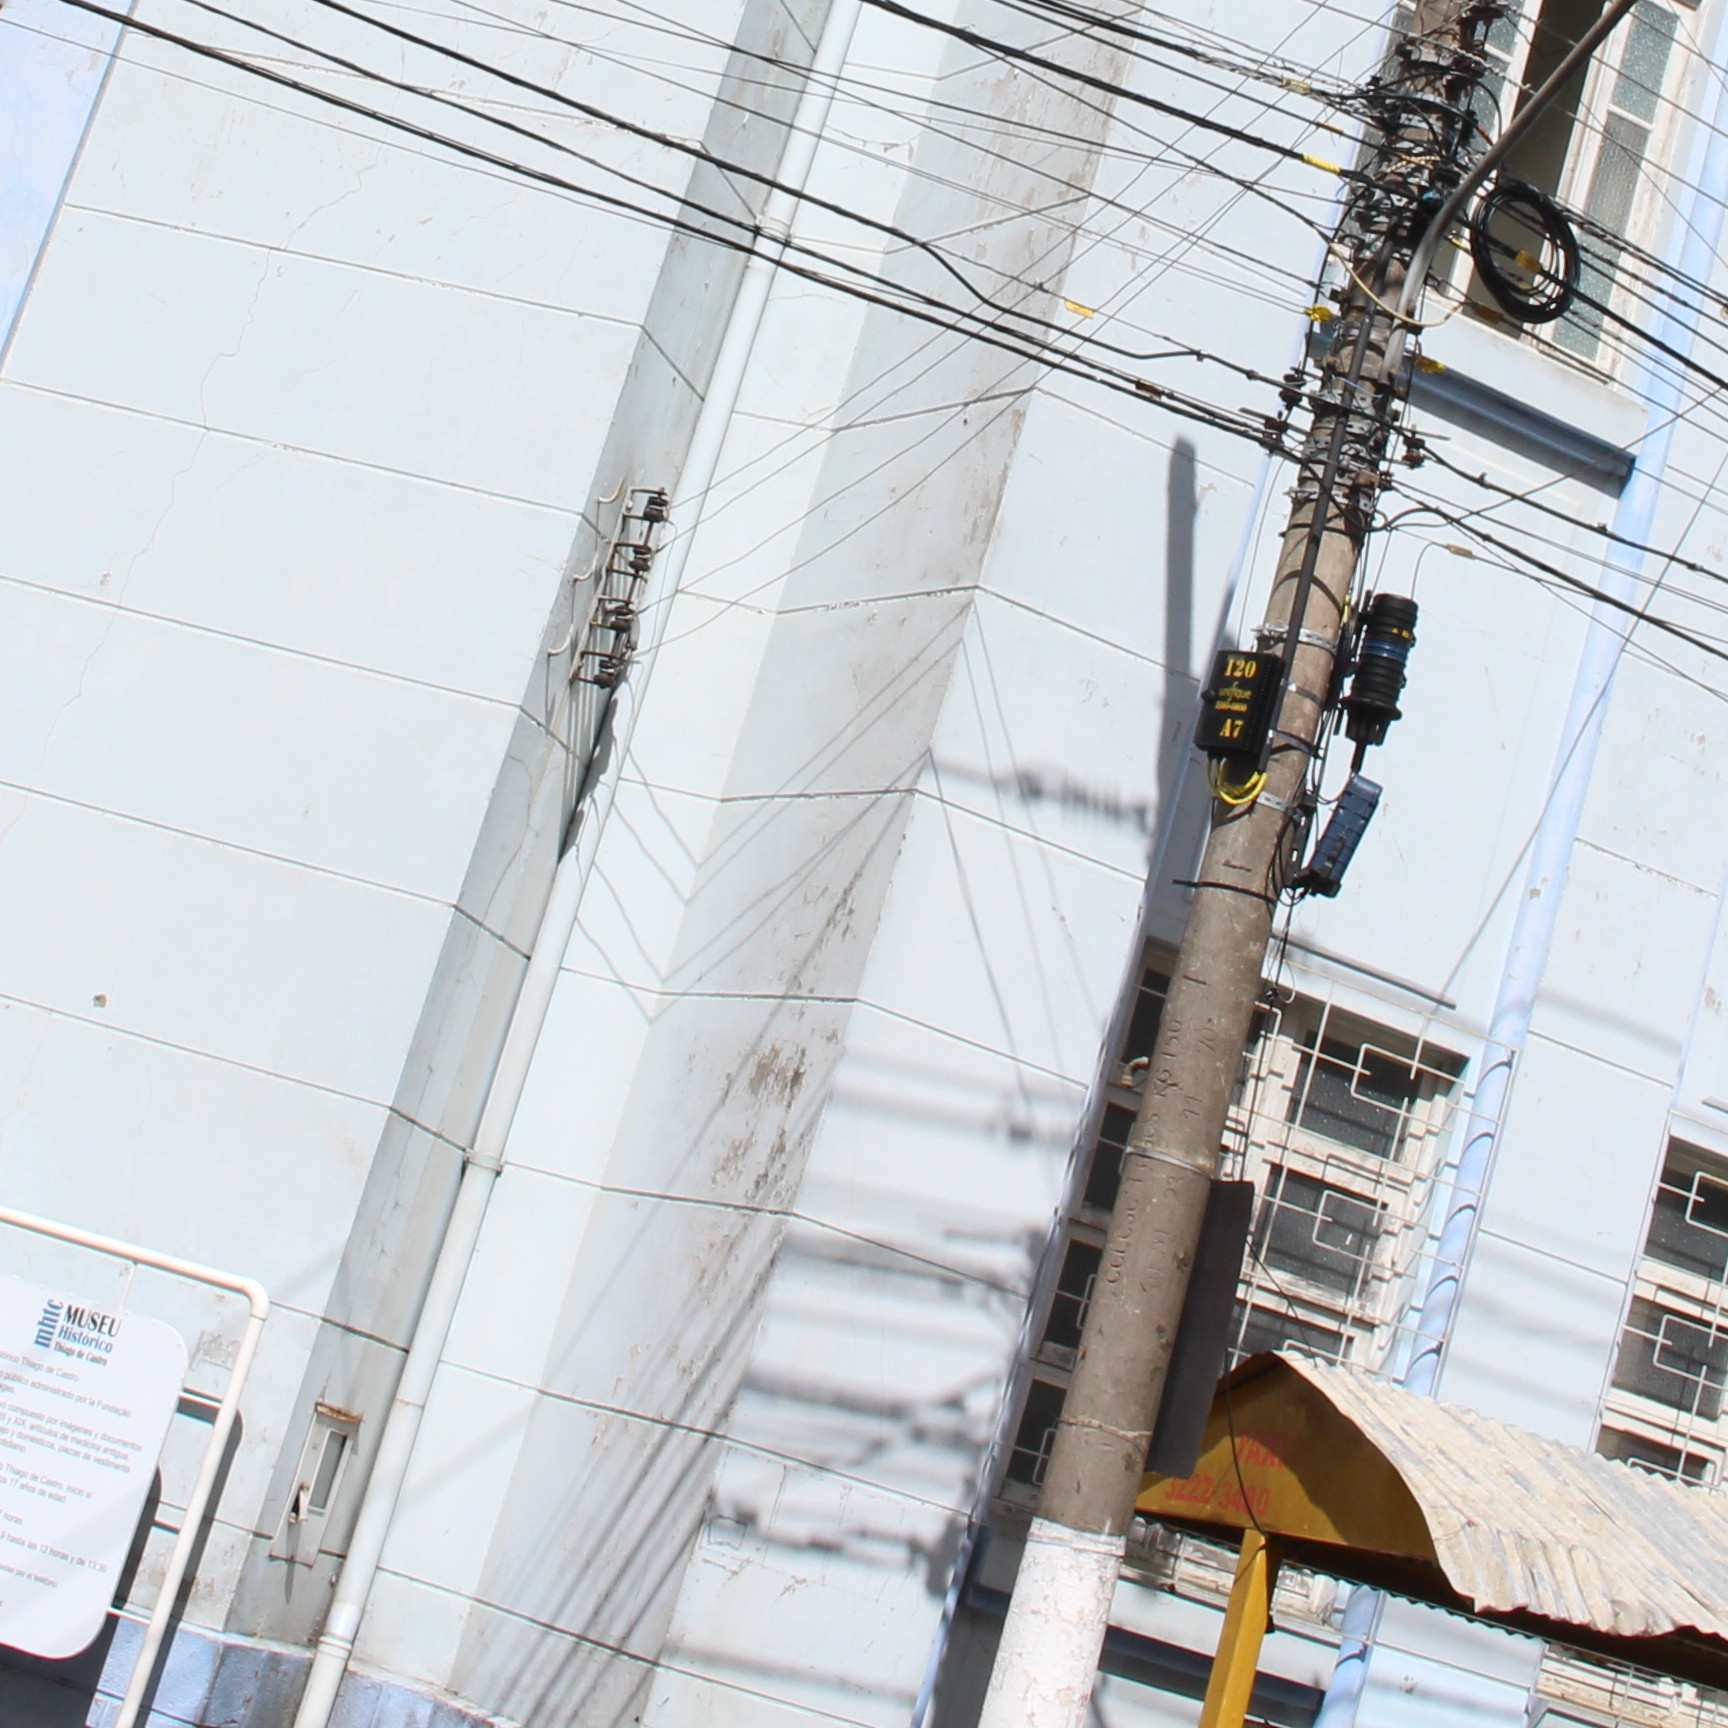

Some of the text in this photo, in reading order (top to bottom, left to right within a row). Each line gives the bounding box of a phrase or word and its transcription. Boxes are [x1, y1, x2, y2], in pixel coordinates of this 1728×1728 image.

[1219, 719, 1244, 738] A7
[34, 1298, 64, 1349] mhtc
[63, 1303, 122, 1337] MUSEU
[58, 1324, 114, 1354] Histórico
